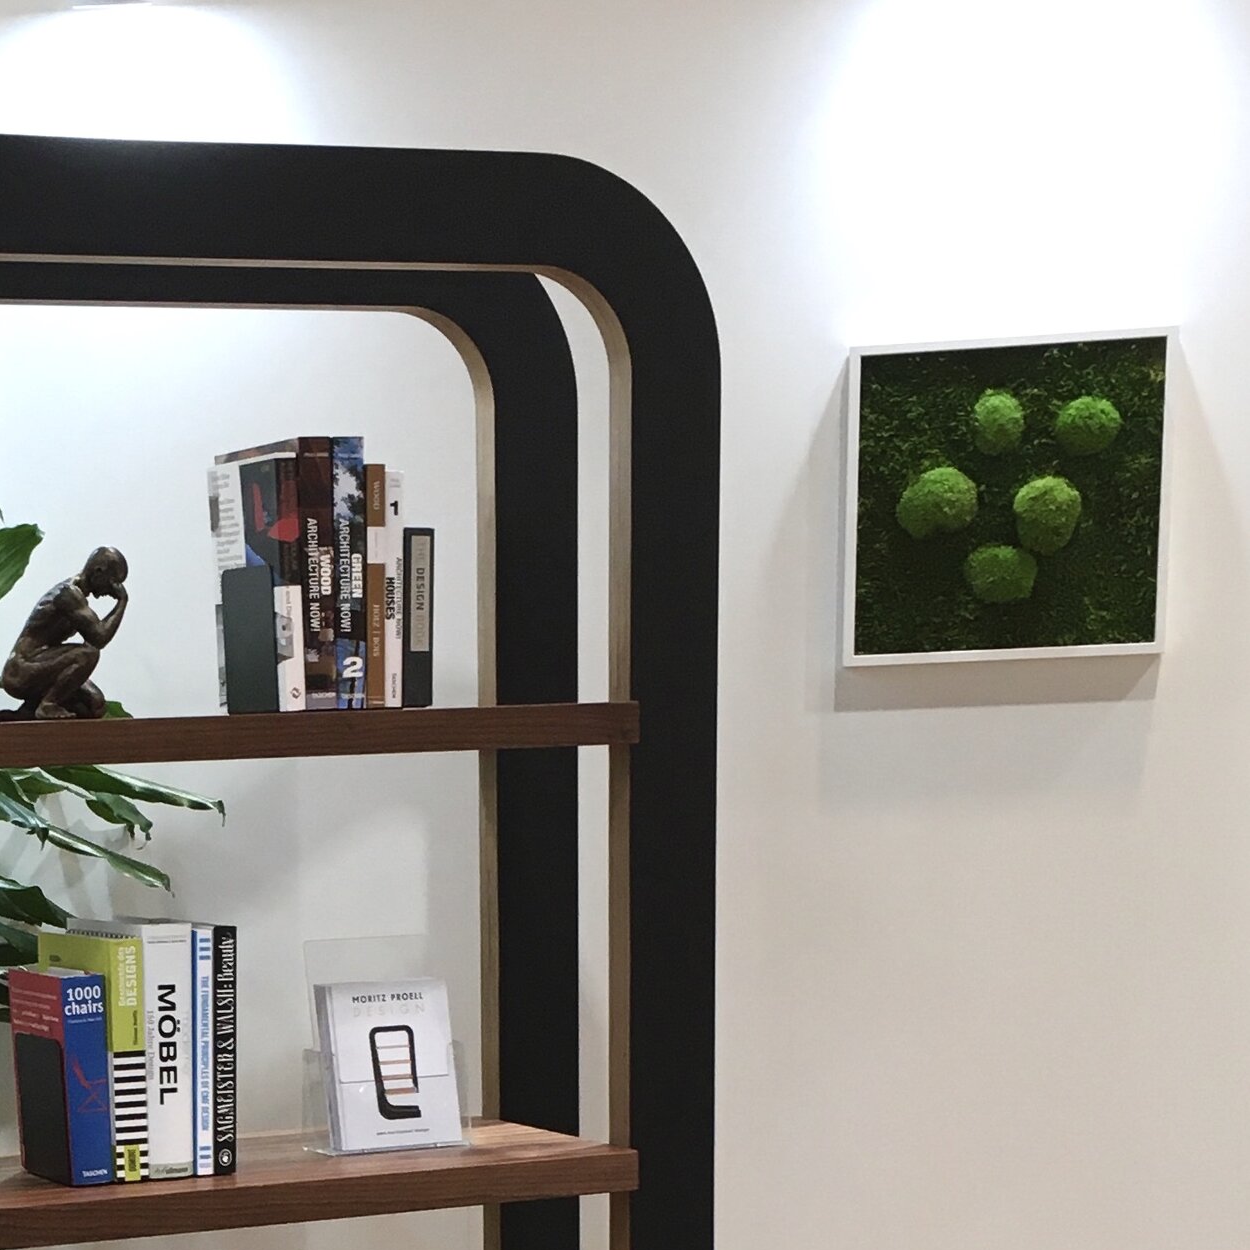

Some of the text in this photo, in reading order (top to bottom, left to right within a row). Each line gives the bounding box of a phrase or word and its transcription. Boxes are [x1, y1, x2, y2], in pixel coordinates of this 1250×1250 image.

[389, 500, 399, 516] 1
[306, 518, 320, 632] ARCHITECTURE NOW!
[319, 553, 332, 596] WOOD
[339, 518, 351, 632] ARCHITECTURE NOW!
[351, 553, 363, 599] GREEN
[395, 557, 404, 617] ARCHITECTURE
[416, 567, 425, 611] DESIGN
[385, 576, 396, 621] HOUSES
[342, 656, 364, 679] 2
[66, 985, 101, 1002] 1000
[124, 945, 138, 1006] DESIGNS
[351, 991, 424, 1004] MORITZ PROELL
[64, 1000, 104, 1016] chairs
[200, 990, 210, 1039] FUNDAMENTAL
[216, 983, 235, 1037] WALSH:
[352, 1003, 426, 1018] DESIGN
[157, 983, 181, 1106] MÖBEL
[217, 1039, 235, 1051] &
[216, 1053, 235, 1142] SAGMEISTER
[81, 1168, 109, 1178] TASCHEN
